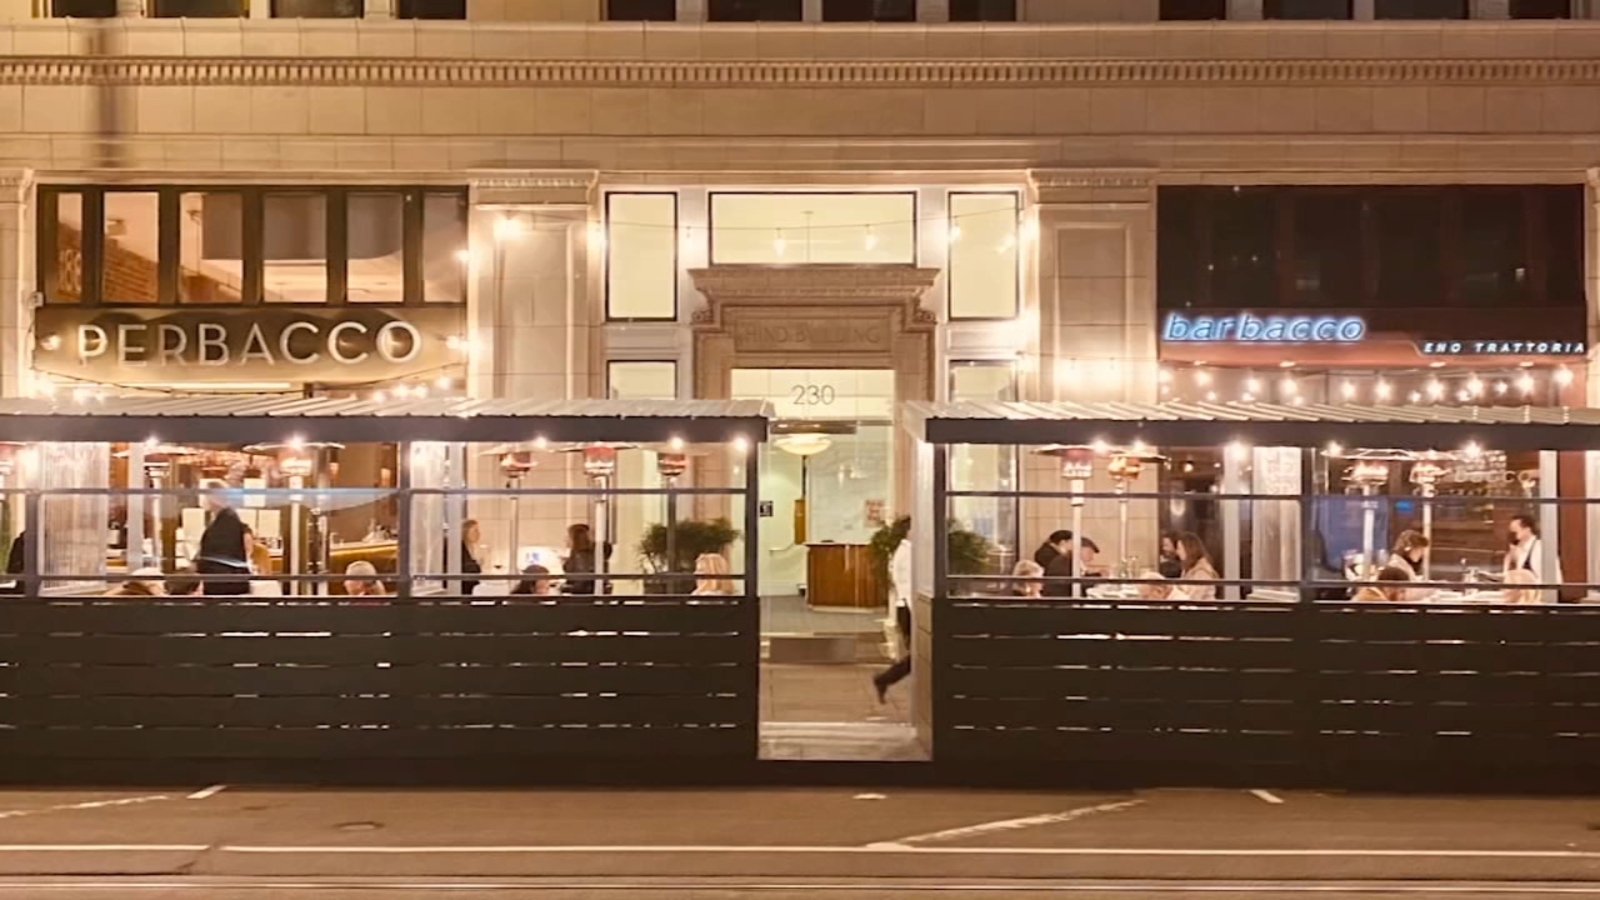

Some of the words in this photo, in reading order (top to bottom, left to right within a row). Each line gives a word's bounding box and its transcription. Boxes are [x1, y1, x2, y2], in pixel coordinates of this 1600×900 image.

[1164, 312, 1365, 342] barbacco
[77, 320, 422, 366] PERBACCO
[1424, 343, 1461, 353] ENO
[1474, 343, 1584, 353] TRATTORIA
[791, 384, 835, 405] 230
